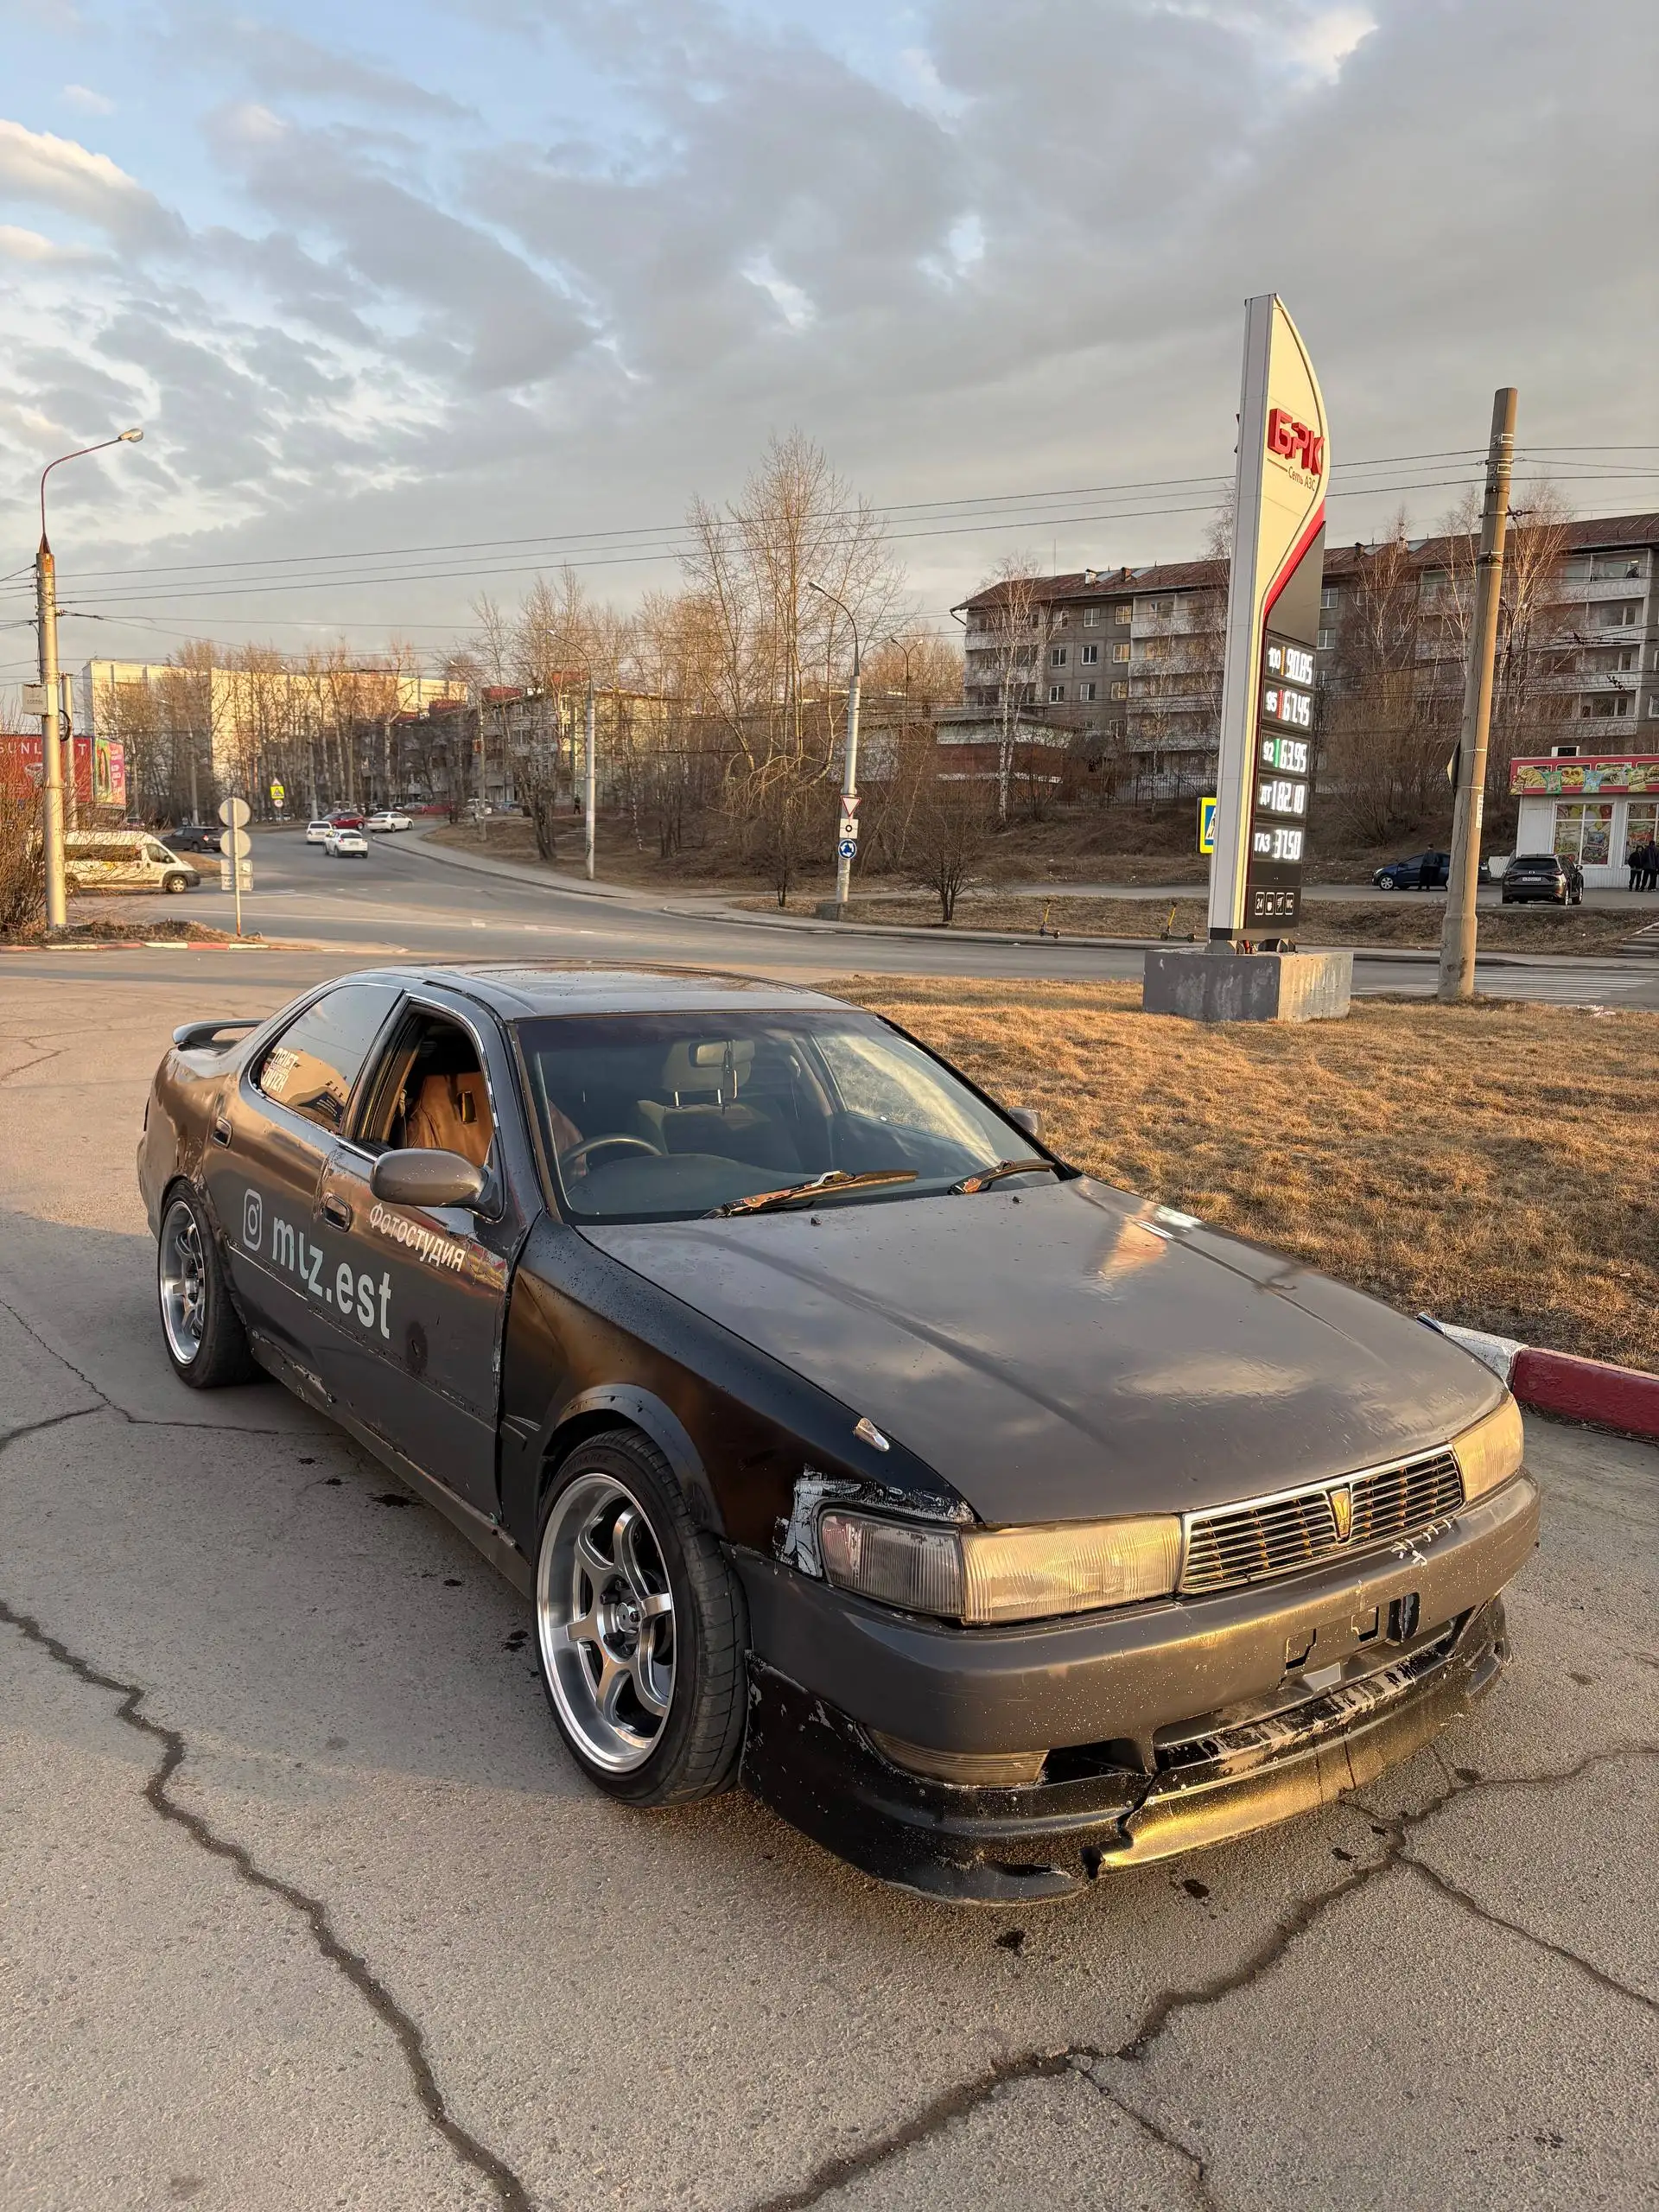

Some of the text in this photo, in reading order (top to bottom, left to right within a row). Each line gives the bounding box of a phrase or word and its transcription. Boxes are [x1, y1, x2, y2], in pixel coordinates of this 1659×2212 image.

[1268, 409, 1325, 475] БРК
[1287, 467, 1316, 492] Сеть АЗС
[1268, 646, 1281, 669] 100
[1266, 691, 1278, 712] 95
[1262, 741, 1274, 761] 92
[1254, 833, 1270, 852] ГАЗ
[1256, 898, 1294, 909] 24 WC
[369, 1203, 467, 1272] Фотостудия
